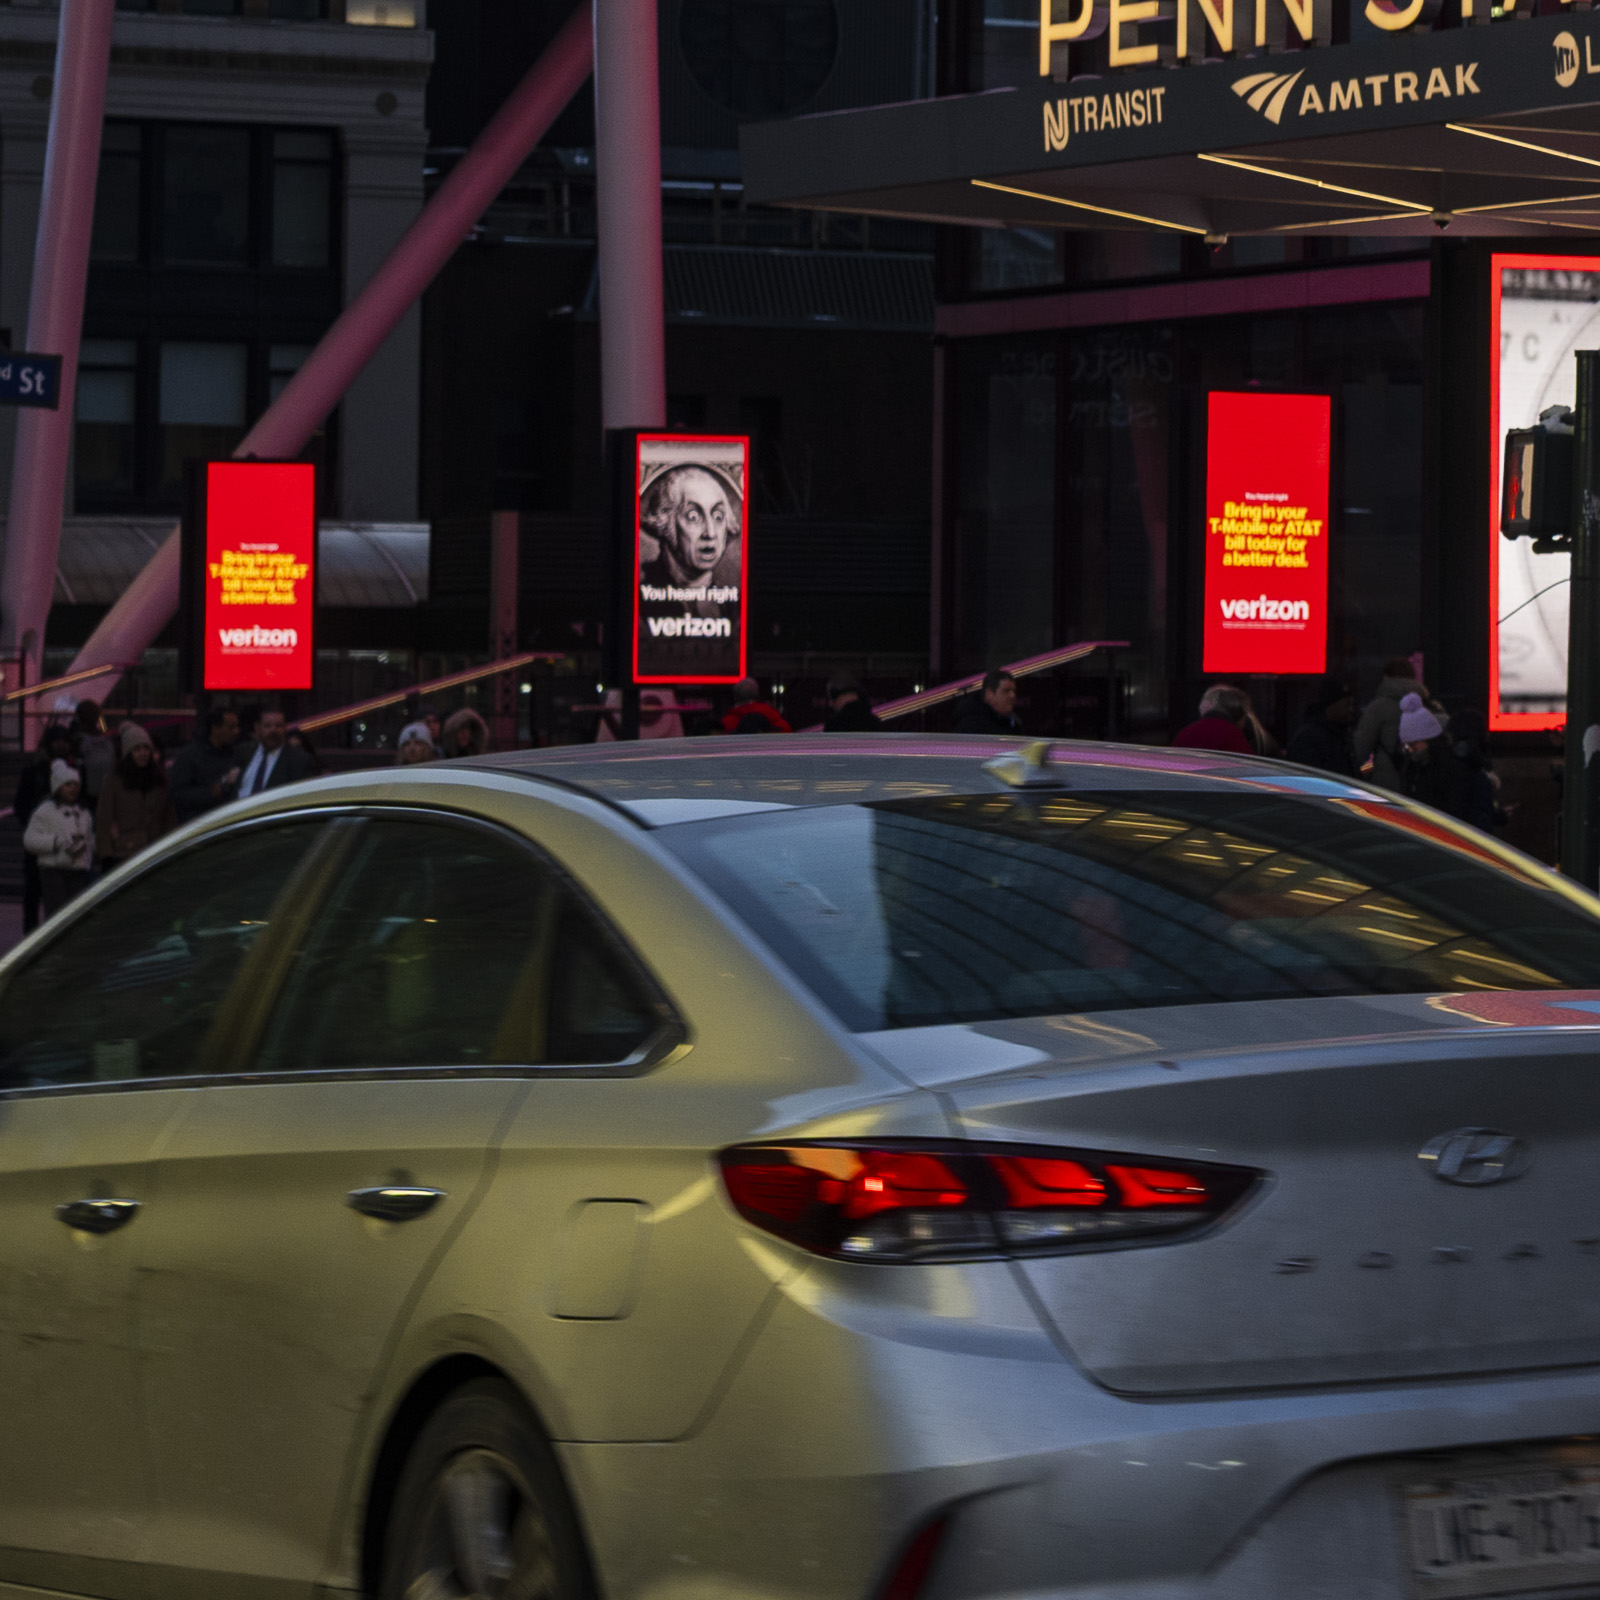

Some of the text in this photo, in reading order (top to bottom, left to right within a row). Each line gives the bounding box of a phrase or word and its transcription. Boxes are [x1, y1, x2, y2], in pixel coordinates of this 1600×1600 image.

[1298, 61, 1481, 117] AMTRAK
[1069, 87, 1166, 134] TRANSIT
[19, 367, 45, 395] St
[1224, 501, 1308, 521] Bring in your
[1209, 518, 1322, 536] T-Mobile or AT&T
[1225, 535, 1307, 553] bill today for
[222, 550, 295, 568] Bring in your
[1223, 552, 1308, 567] a better deal.
[209, 563, 308, 579] T-Mobile or AT&T
[223, 578, 294, 593] bill today for
[640, 584, 738, 603] You heard right
[229, 591, 265, 605] better
[1220, 594, 1309, 620] verizon
[648, 612, 731, 637] verizon
[219, 625, 297, 647] verizon
